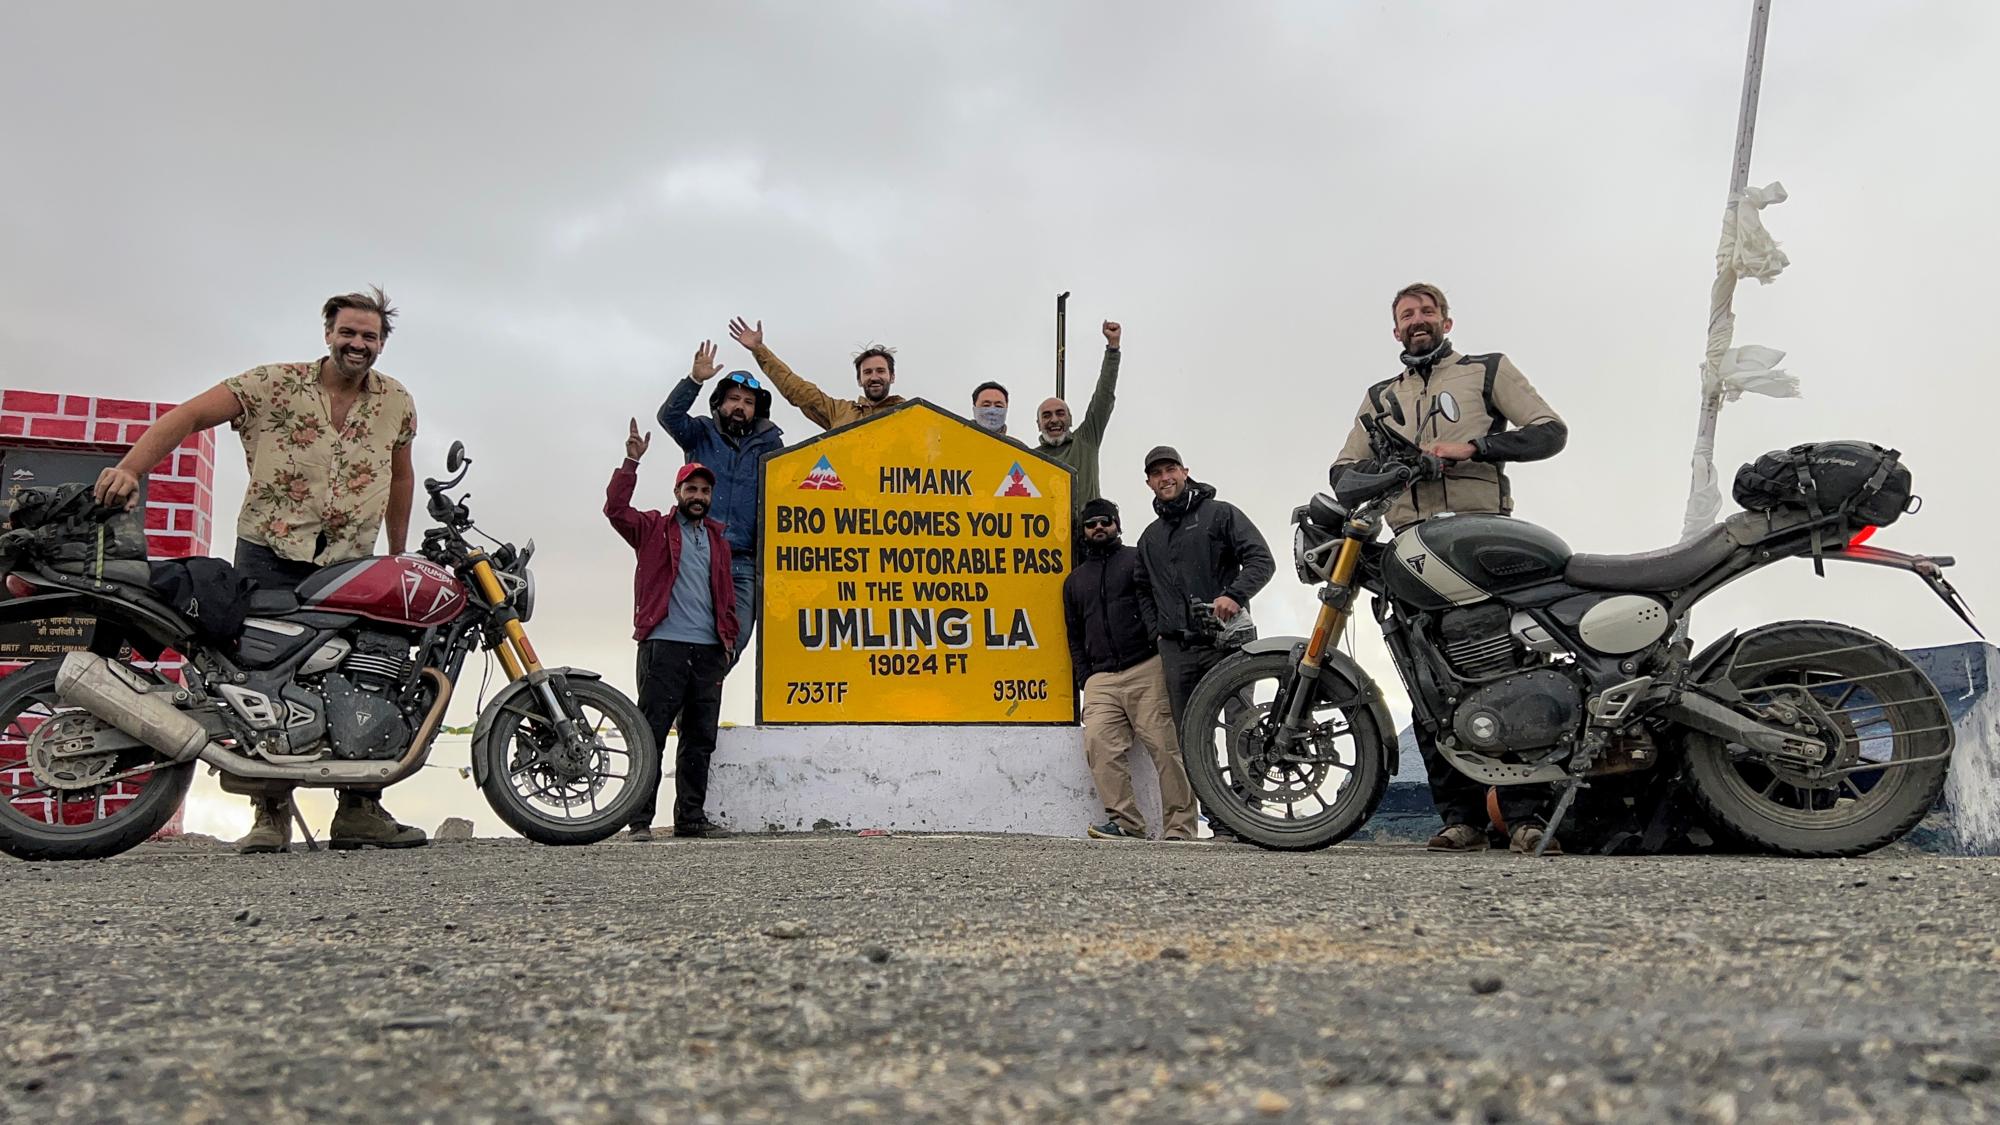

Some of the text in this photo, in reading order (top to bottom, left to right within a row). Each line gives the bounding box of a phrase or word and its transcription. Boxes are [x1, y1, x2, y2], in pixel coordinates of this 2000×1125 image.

[879, 466, 973, 496] HIMANK
[776, 505, 1050, 538] BRO WELCOMES YOU TO
[412, 561, 453, 586] TRIUMPH
[776, 546, 1064, 575] HIGHEST MOTORABLE PASS
[838, 581, 989, 602] IN THE WORLD
[798, 608, 1039, 650] UMLING LA
[29, 645, 60, 653] PROJECT
[120, 646, 130, 654] CC
[869, 654, 968, 675] 19024 FT
